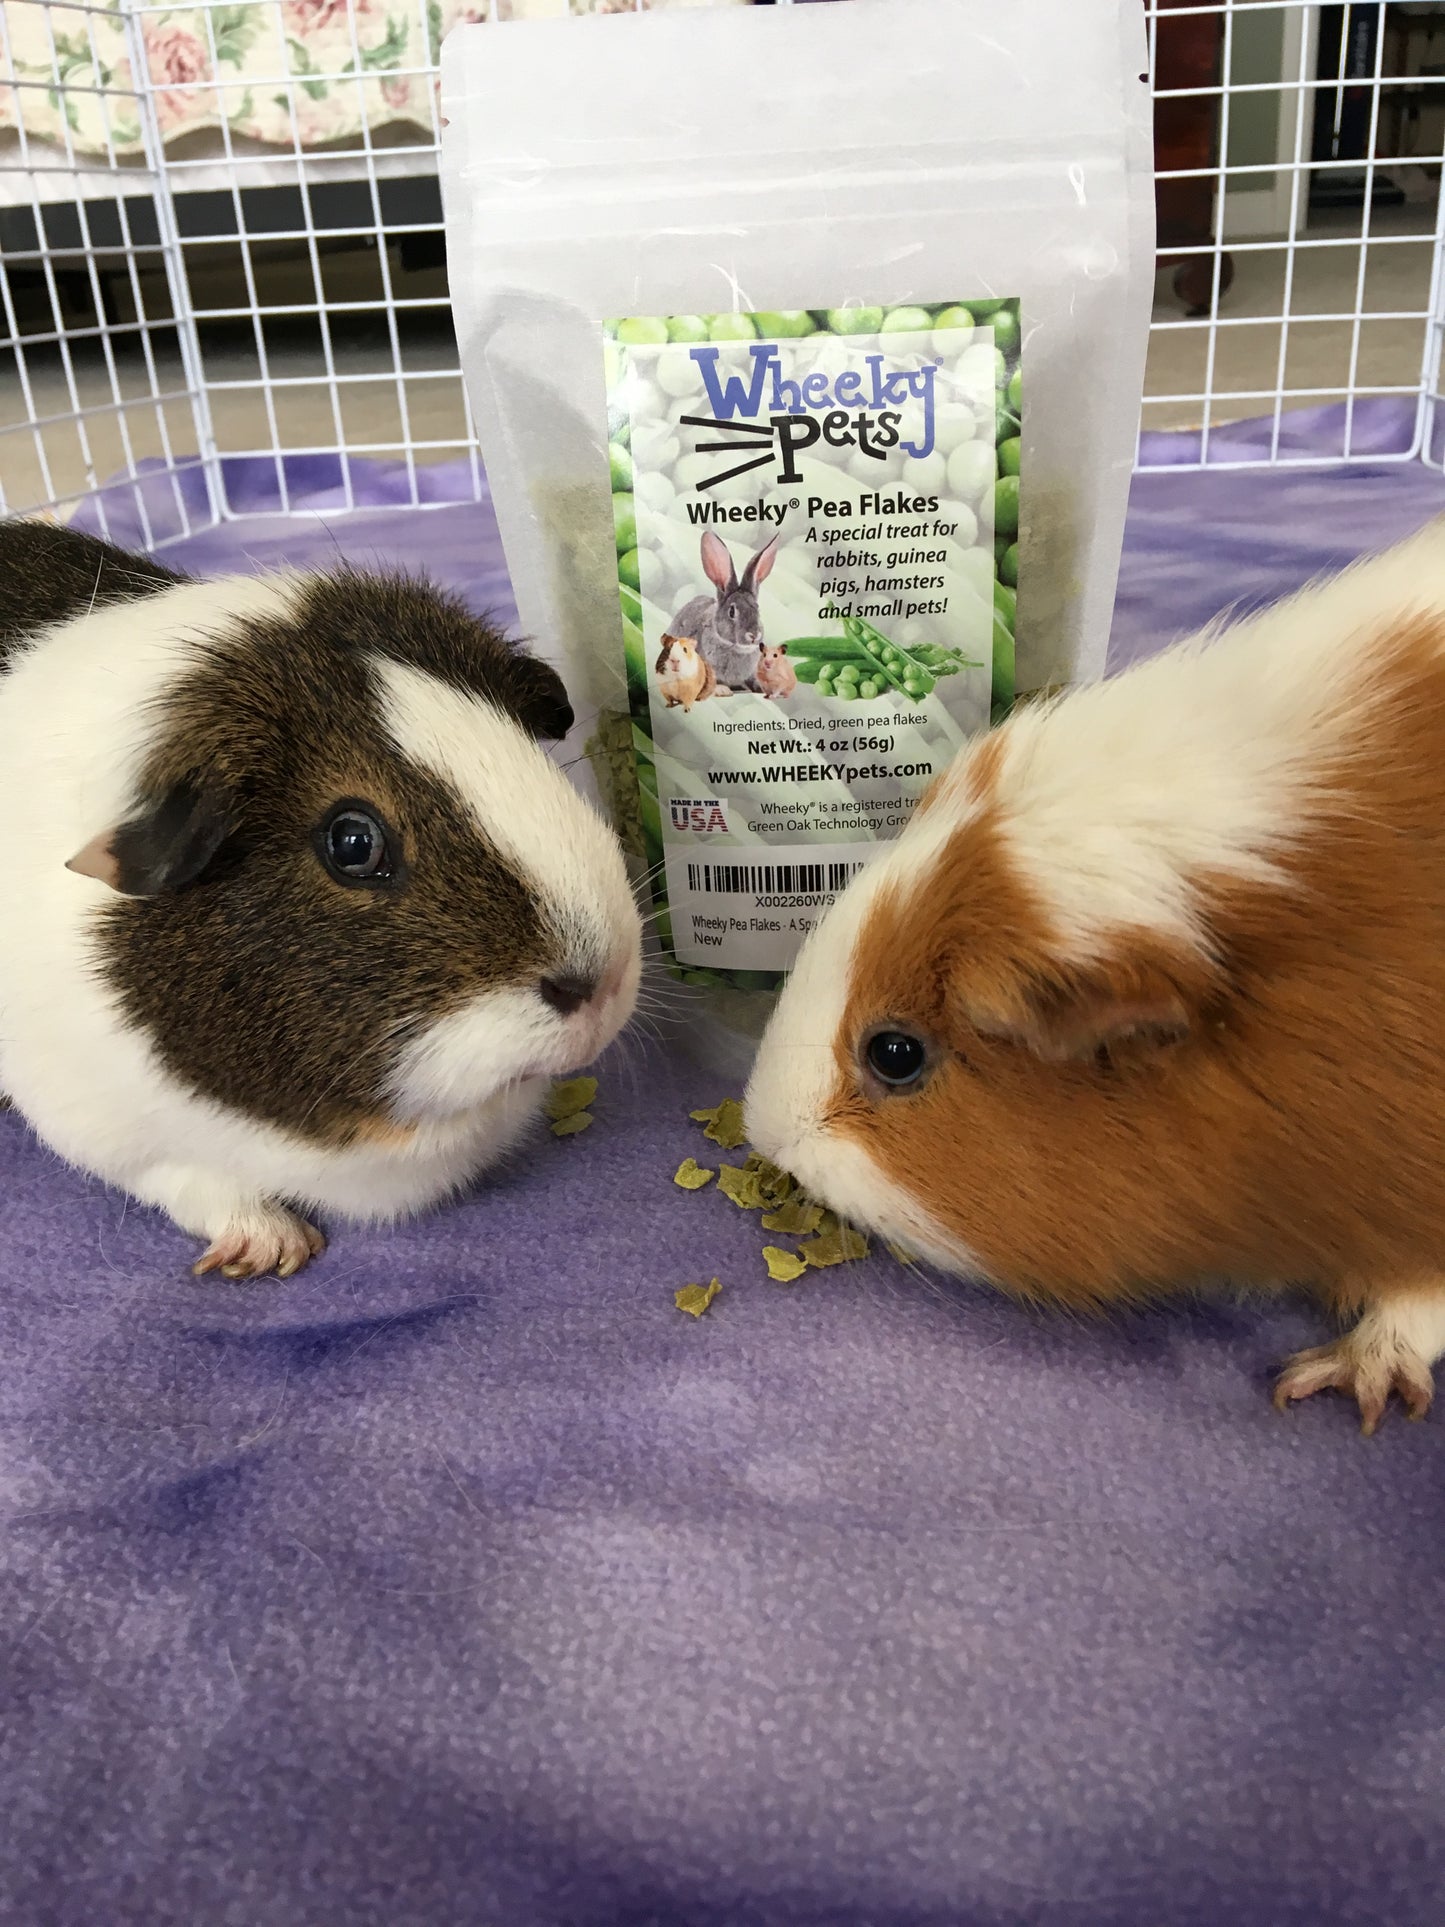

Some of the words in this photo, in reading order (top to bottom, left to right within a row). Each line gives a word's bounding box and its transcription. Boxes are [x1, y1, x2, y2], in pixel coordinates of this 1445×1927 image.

[687, 498, 800, 526] Wheeky®
[808, 496, 852, 518] Pea
[859, 491, 939, 515] Flakes
[806, 527, 818, 543] A
[822, 522, 882, 546] special
[886, 522, 928, 539] treat
[931, 519, 958, 539] for
[817, 550, 882, 569] rabbits,
[886, 549, 947, 569] guinea
[820, 578, 860, 597] pigs,
[865, 575, 944, 593] hamsters
[818, 602, 852, 619] and
[856, 600, 902, 617] small
[905, 598, 948, 618] pets!
[713, 721, 786, 735] Ingredients:
[789, 718, 825, 731] Dried,
[828, 718, 863, 731] green
[867, 716, 890, 729] pea
[893, 714, 927, 725] flakes
[748, 741, 776, 754] Net
[780, 740, 812, 753] Wt.:
[816, 739, 825, 752] 4
[830, 740, 848, 751] oz
[853, 736, 895, 752] (56g)
[708, 761, 932, 784] www.WHEEKYpets.com
[819, 801, 828, 812] is
[832, 803, 839, 812] a
[841, 797, 902, 812] registered
[671, 807, 728, 832] USA
[748, 820, 784, 832] Green
[787, 819, 811, 830] Oak
[813, 816, 883, 831] Technology
[692, 915, 727, 933] Wheeky
[730, 917, 747, 930] Pea
[750, 918, 780, 931] Flakes
[790, 918, 796, 930] A
[694, 932, 722, 945] New
